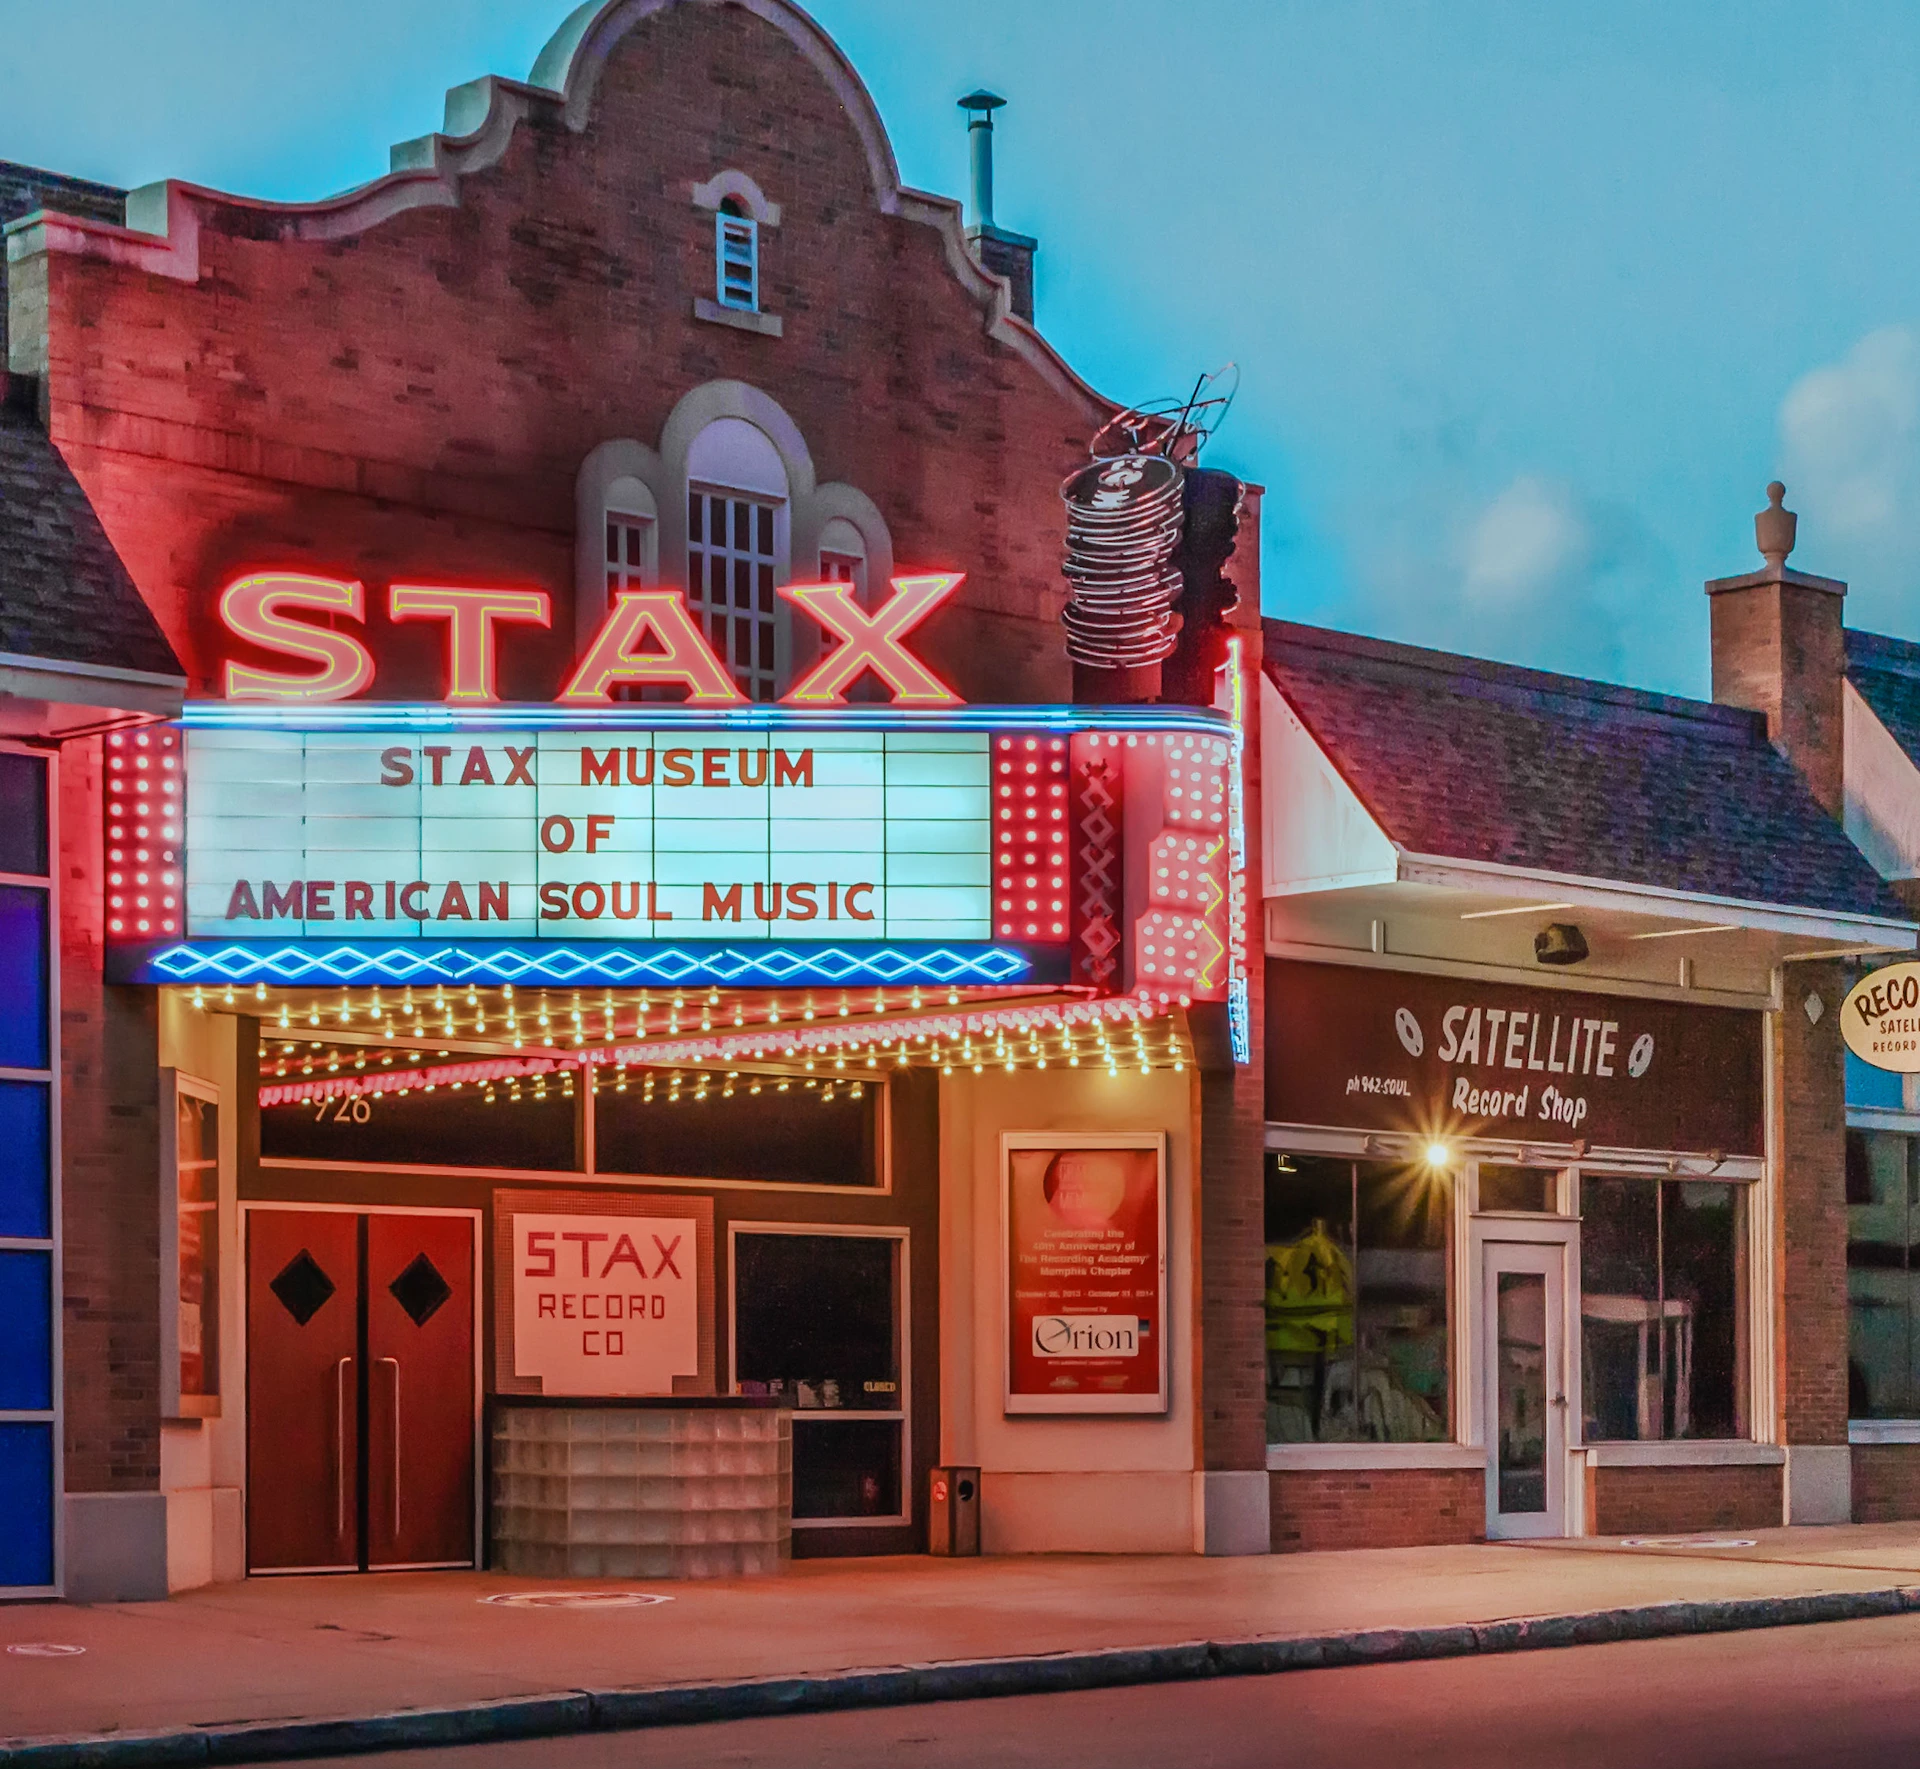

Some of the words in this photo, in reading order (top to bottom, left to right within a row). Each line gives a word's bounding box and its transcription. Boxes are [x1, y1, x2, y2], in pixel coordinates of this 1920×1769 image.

[218, 569, 967, 705] STAX
[380, 745, 538, 787] STAX
[580, 747, 815, 789] MUSEUM
[540, 813, 616, 854] OF
[225, 878, 510, 921] AMERICAN
[540, 880, 673, 921] SOUL
[702, 880, 876, 923] MUSIC
[1437, 1005, 1619, 1077] SATELLITE
[1873, 1040, 1917, 1052] RECORD
[312, 1087, 371, 1123] 926
[1452, 1076, 1529, 1117] Record
[1538, 1085, 1588, 1129] Shop
[1059, 1242, 1121, 1252] Anniversary
[1125, 1241, 1135, 1250] of
[1107, 1230, 1124, 1238] the
[525, 1232, 682, 1279] STAX
[1040, 1254, 1094, 1265] Recording
[1040, 1267, 1087, 1277] Memphis
[1090, 1267, 1133, 1277] Chapter
[538, 1293, 665, 1319] RECORD
[582, 1330, 624, 1356] CO
[1035, 1317, 1134, 1354] Orion
